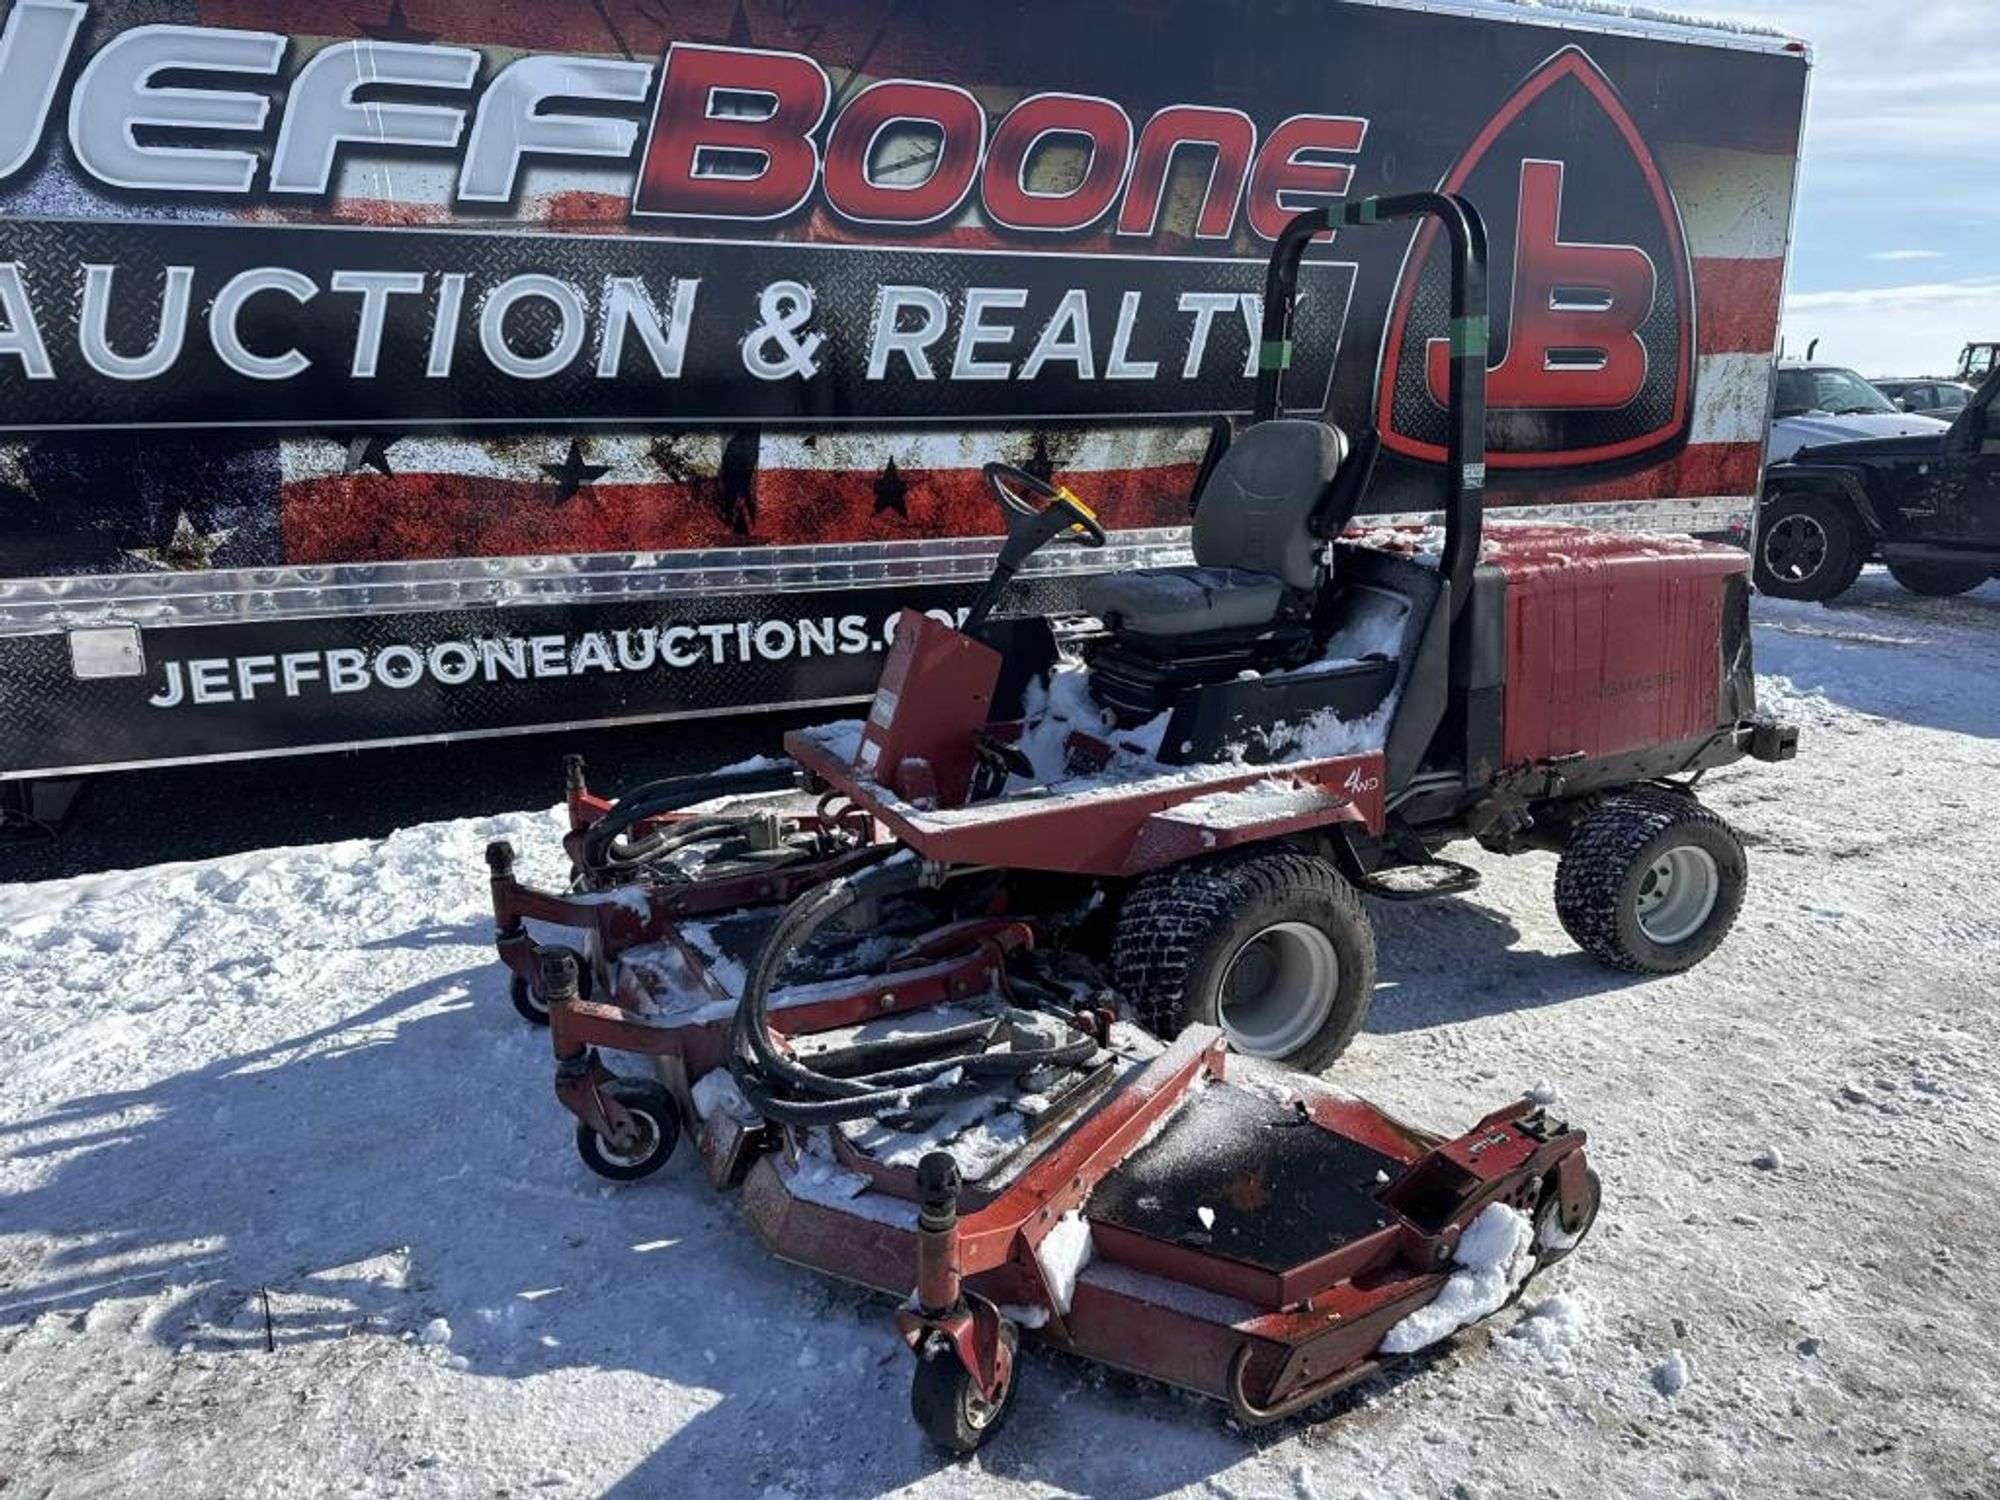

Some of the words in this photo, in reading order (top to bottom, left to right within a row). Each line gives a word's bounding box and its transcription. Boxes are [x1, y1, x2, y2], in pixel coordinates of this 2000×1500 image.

[741, 279, 826, 381] &
[866, 284, 1306, 380] REALTY
[149, 606, 972, 708] JEFFBOONEAUCTIONS.
